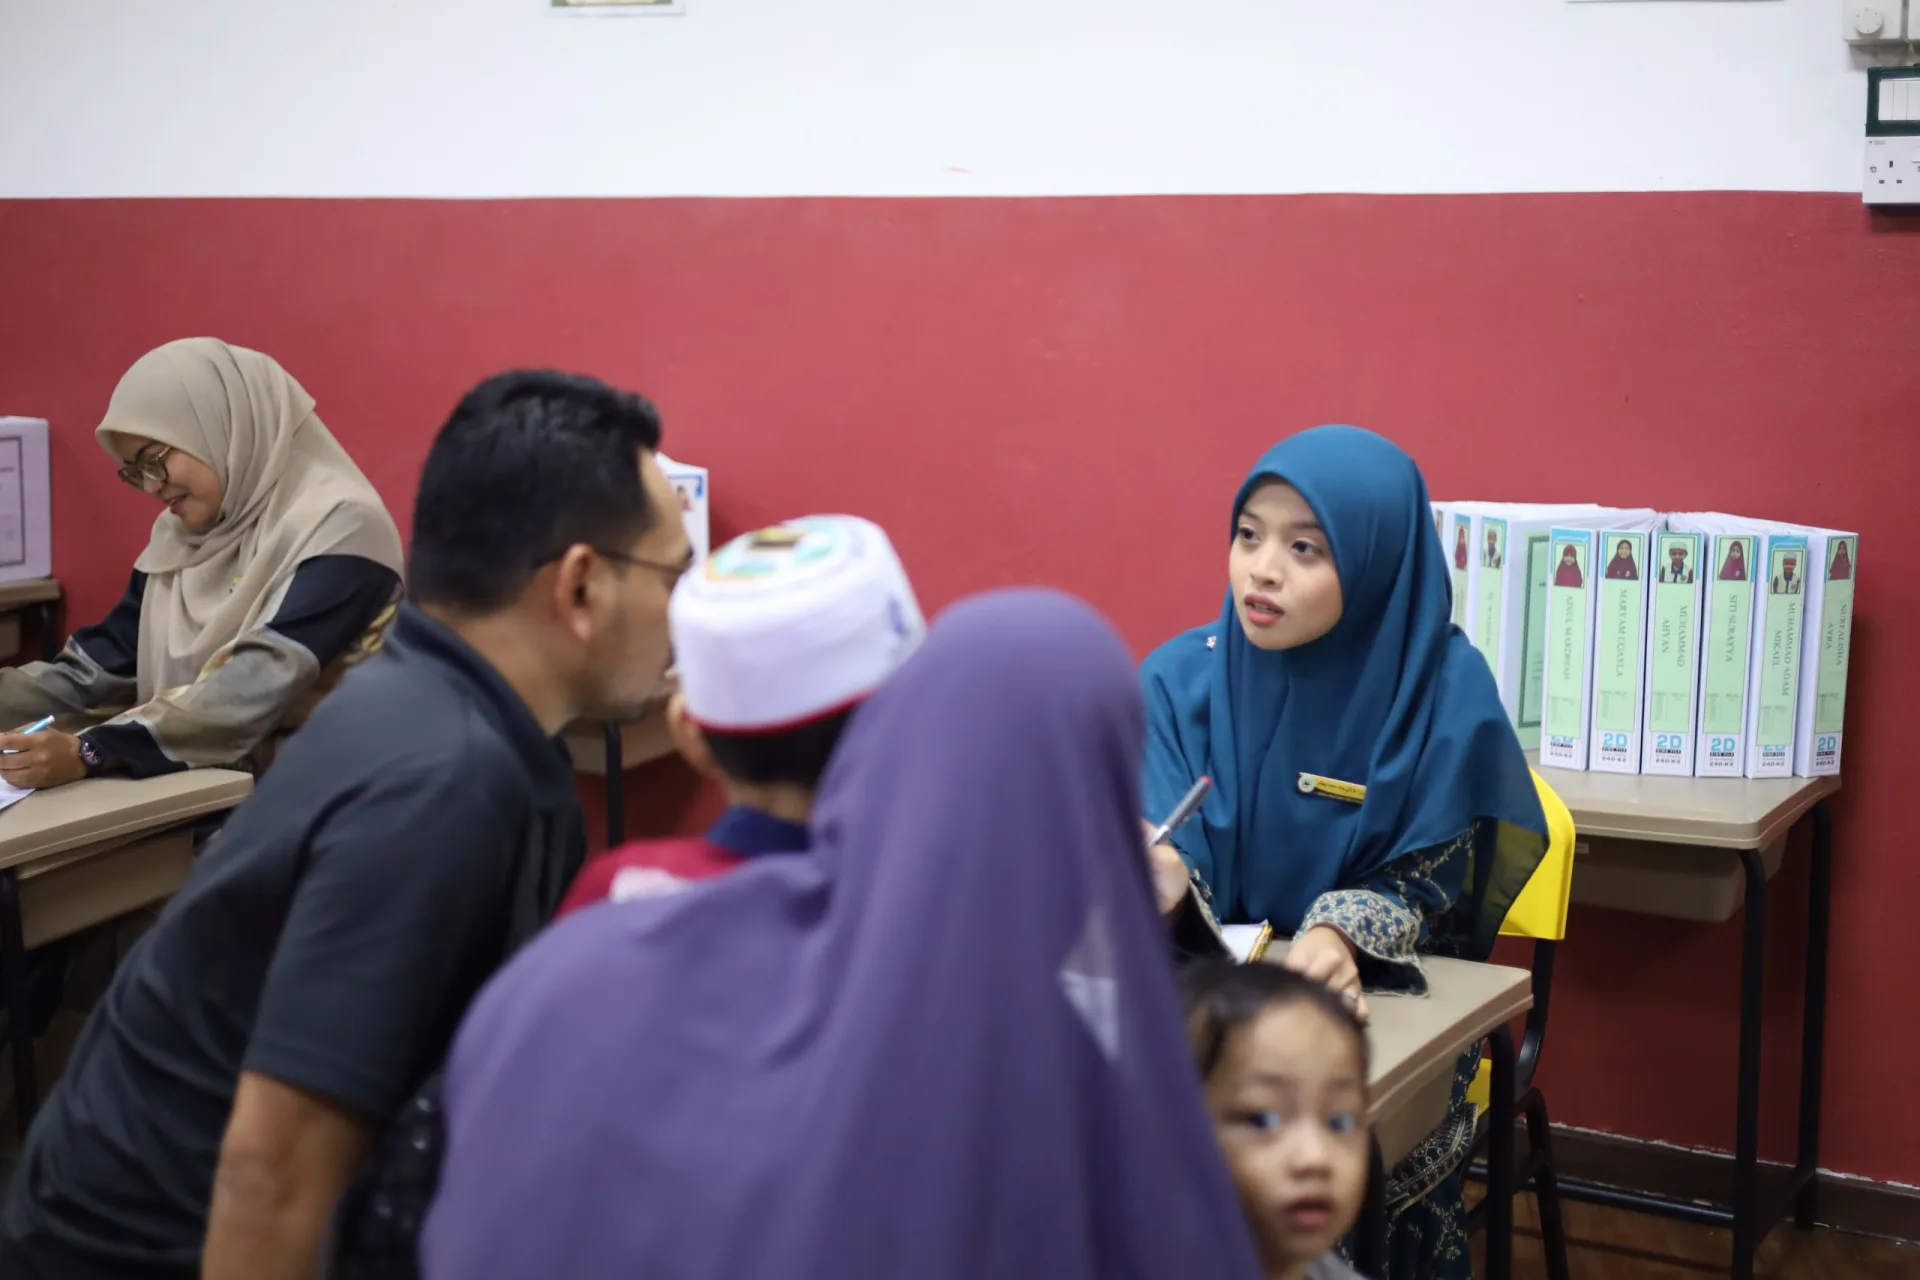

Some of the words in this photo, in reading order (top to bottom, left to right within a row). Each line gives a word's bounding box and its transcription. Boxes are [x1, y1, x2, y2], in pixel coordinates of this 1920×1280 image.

[1618, 589, 1628, 634] MARYAM
[1728, 594, 1738, 612] SITI
[1662, 618, 1671, 653] AHYAN
[1678, 605, 1688, 667] MUHAMMAD
[1725, 615, 1737, 662] SURAYYA
[1772, 630, 1782, 667] MIKAEL
[1784, 602, 1796, 664] MUHAMMAD
[1826, 622, 1835, 649] AYRA
[1616, 636, 1627, 677] UQAYLA
[1781, 667, 1790, 696] ADAM
[1603, 732, 1628, 747] 2D
[1656, 734, 1682, 749] 2D
[1711, 737, 1736, 752] 2D
[1818, 736, 1837, 751] 2D
